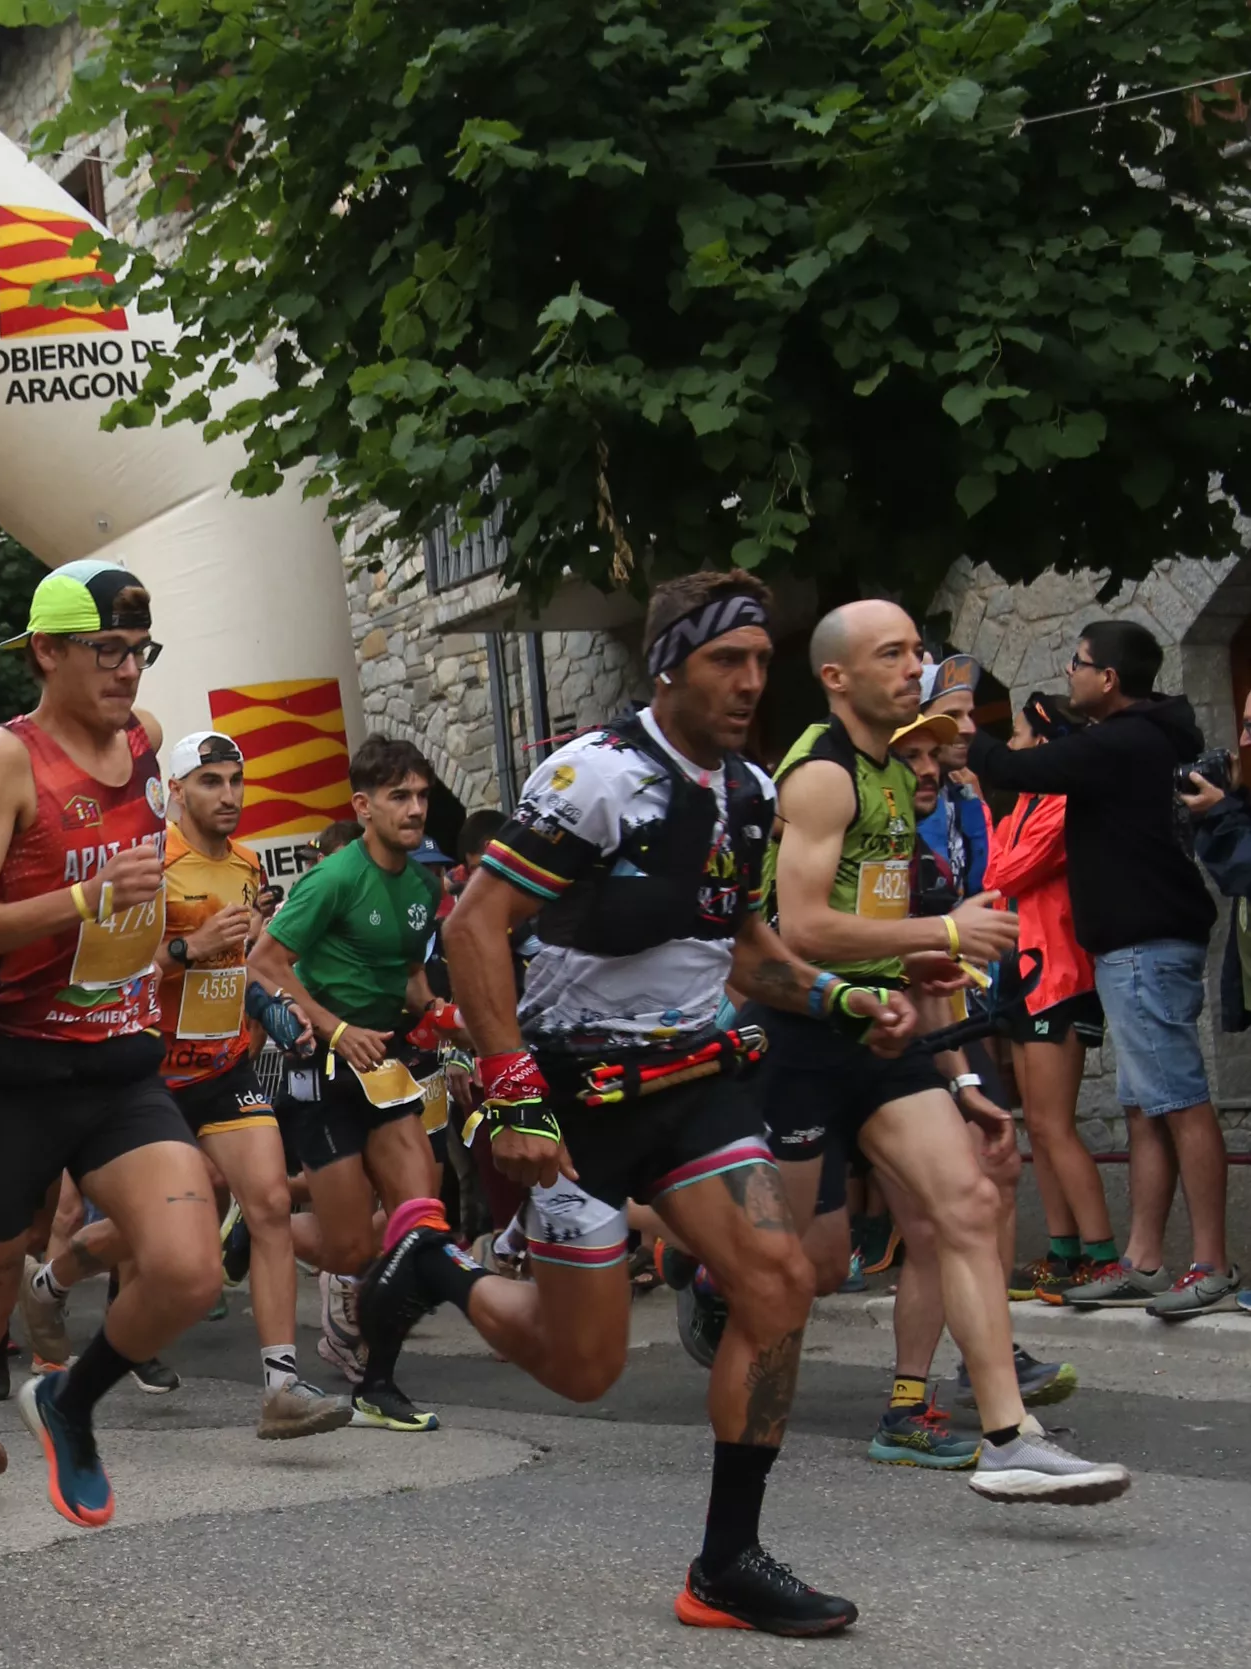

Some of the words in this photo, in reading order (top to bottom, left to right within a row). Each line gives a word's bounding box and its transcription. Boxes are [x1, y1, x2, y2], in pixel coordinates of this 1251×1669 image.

[5, 371, 138, 405] ARAGON
[197, 976, 237, 1000] 4555
[235, 1090, 271, 1107] ide
